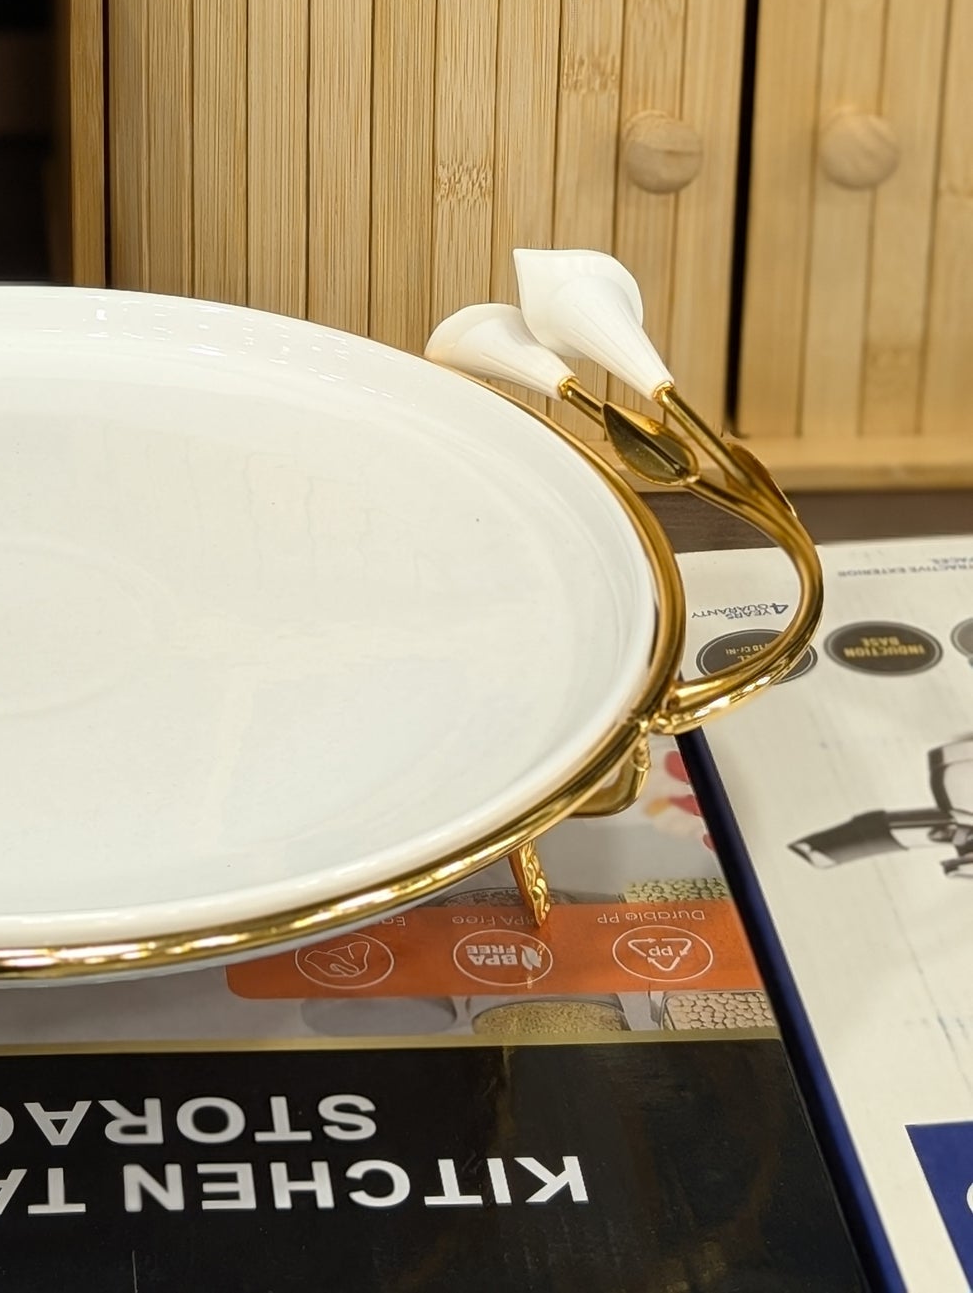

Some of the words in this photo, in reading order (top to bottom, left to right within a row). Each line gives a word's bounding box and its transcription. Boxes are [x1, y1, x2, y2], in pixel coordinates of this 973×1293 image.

[770, 603, 788, 615] 4
[861, 636, 900, 647] BASE
[842, 644, 926, 657] INDUCTION
[451, 915, 496, 926] Free
[625, 908, 706, 924] Durable
[465, 944, 517, 955] FREE
[468, 953, 520, 966] BPA
[123, 1155, 589, 1212] KITCHEN
